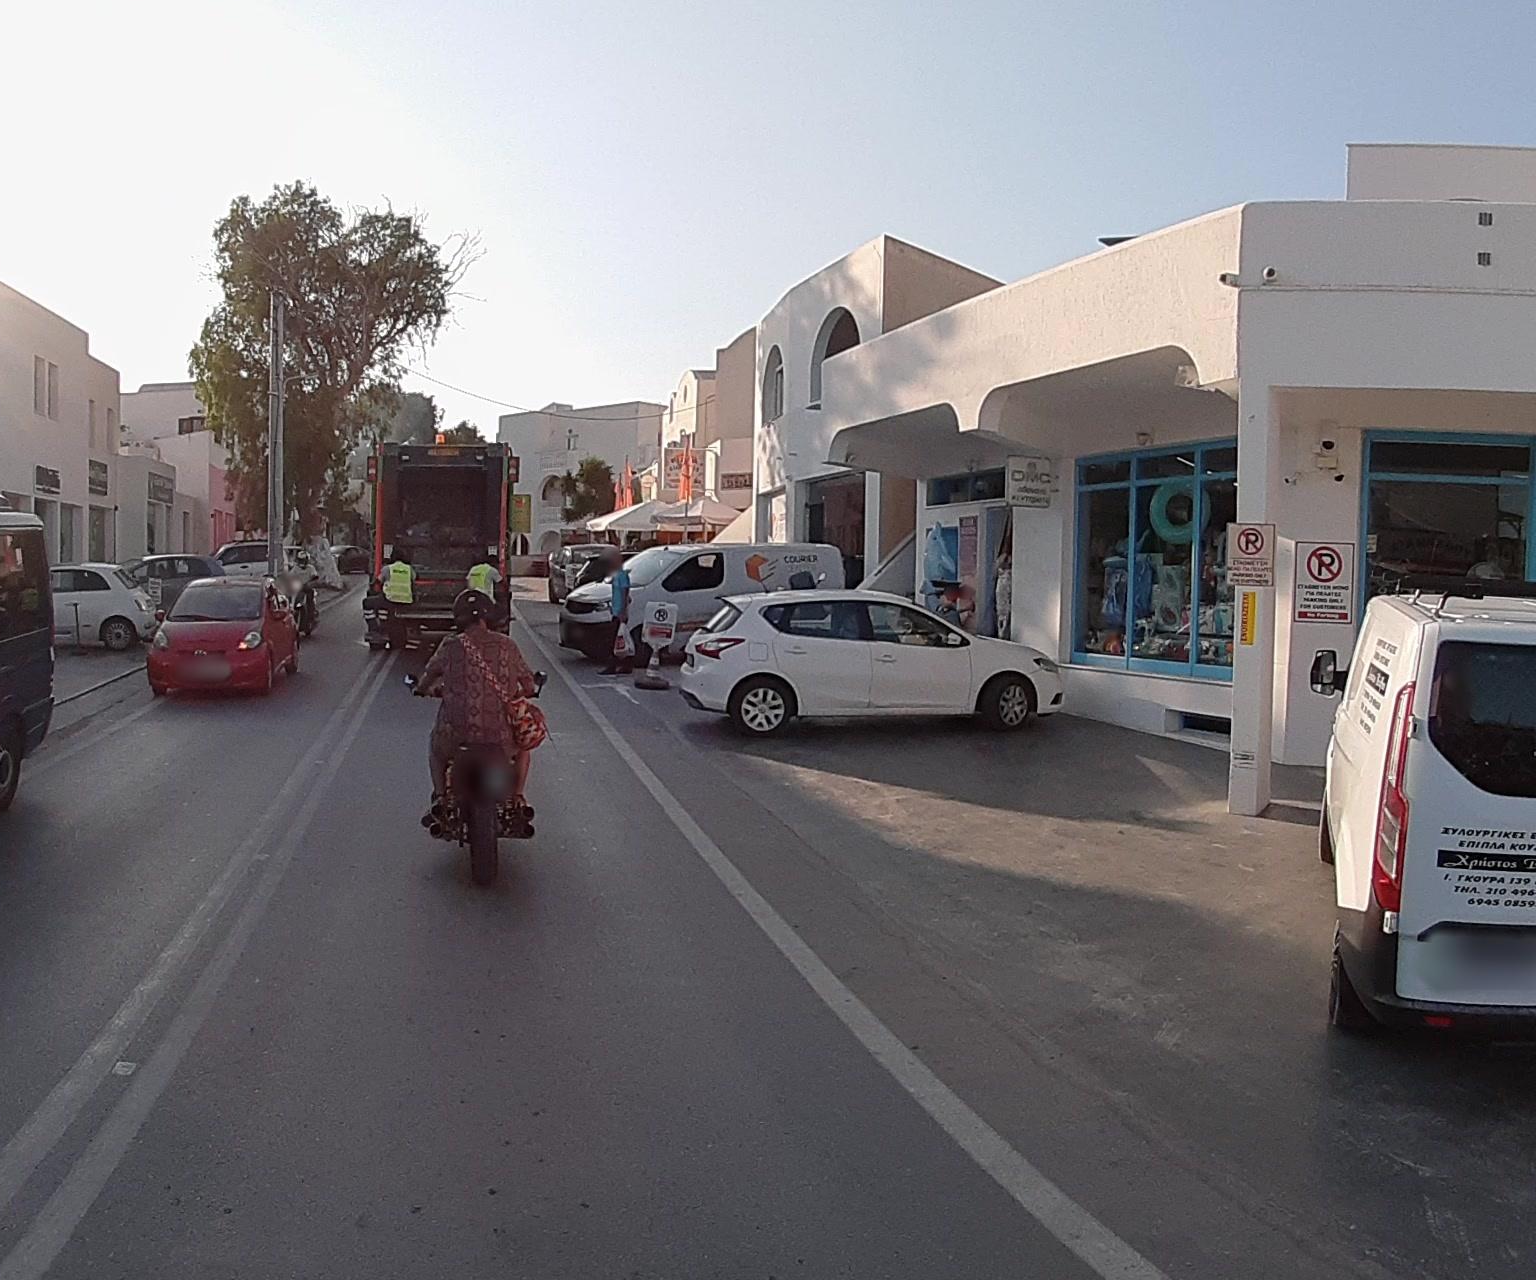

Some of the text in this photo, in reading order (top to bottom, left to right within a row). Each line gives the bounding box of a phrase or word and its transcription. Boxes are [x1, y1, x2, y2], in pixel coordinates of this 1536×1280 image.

[784, 554, 819, 565] COURIER
[1458, 839, 1505, 850] ΕΠΙΠΛΑ
[1457, 874, 1505, 885] ΓΚΟΥΡΑ
[1509, 877, 1530, 886] 139
[1485, 887, 1507, 896] 210
